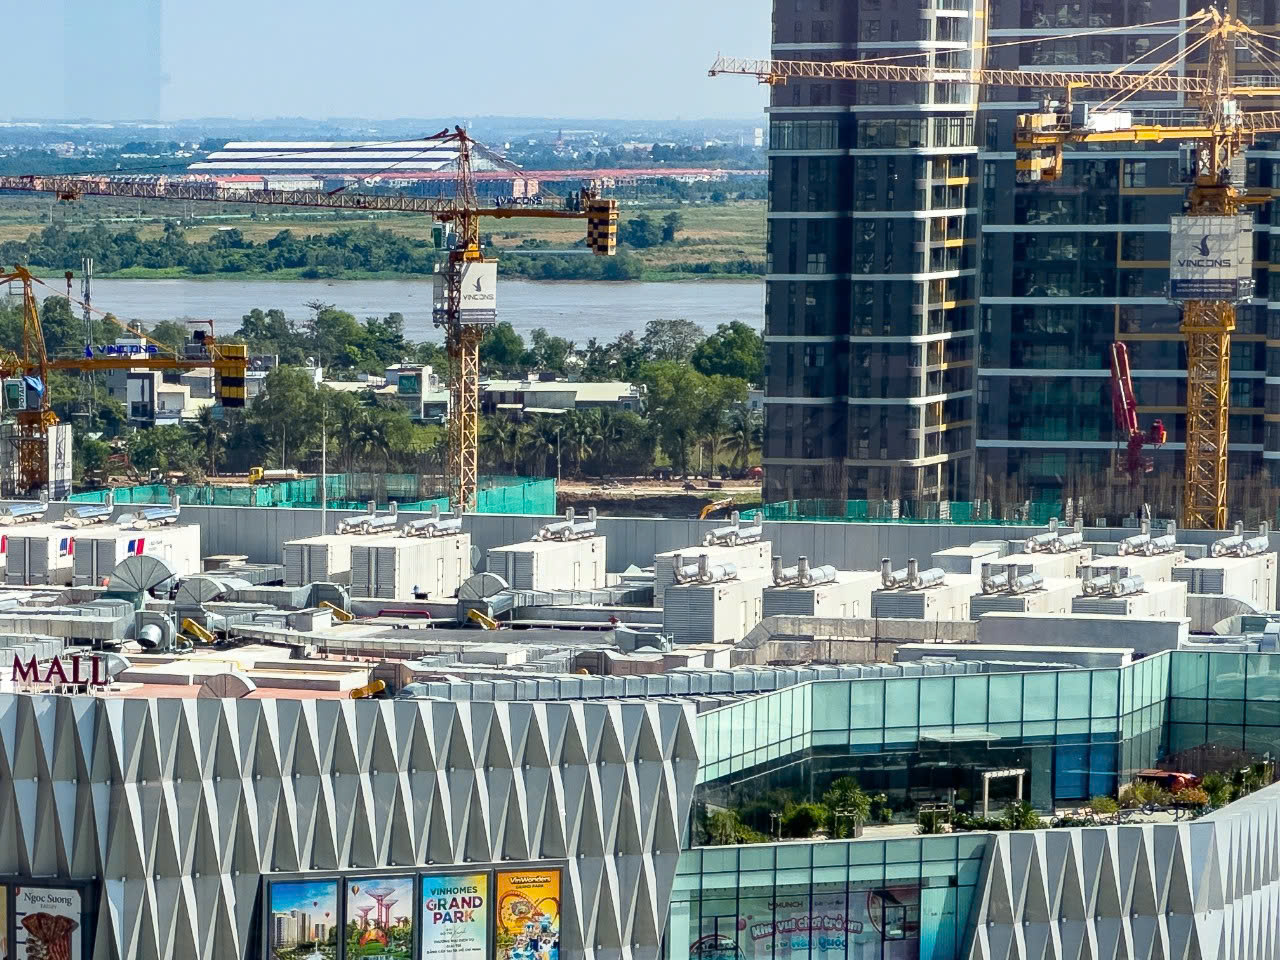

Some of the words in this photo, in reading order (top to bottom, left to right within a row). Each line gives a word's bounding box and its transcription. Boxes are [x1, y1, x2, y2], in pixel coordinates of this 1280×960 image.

[11, 655, 110, 686] MALL
[510, 876, 552, 884] VinWonders
[430, 886, 478, 896] VINHOMES
[426, 896, 483, 911] GRAND
[433, 909, 475, 925] PARK
